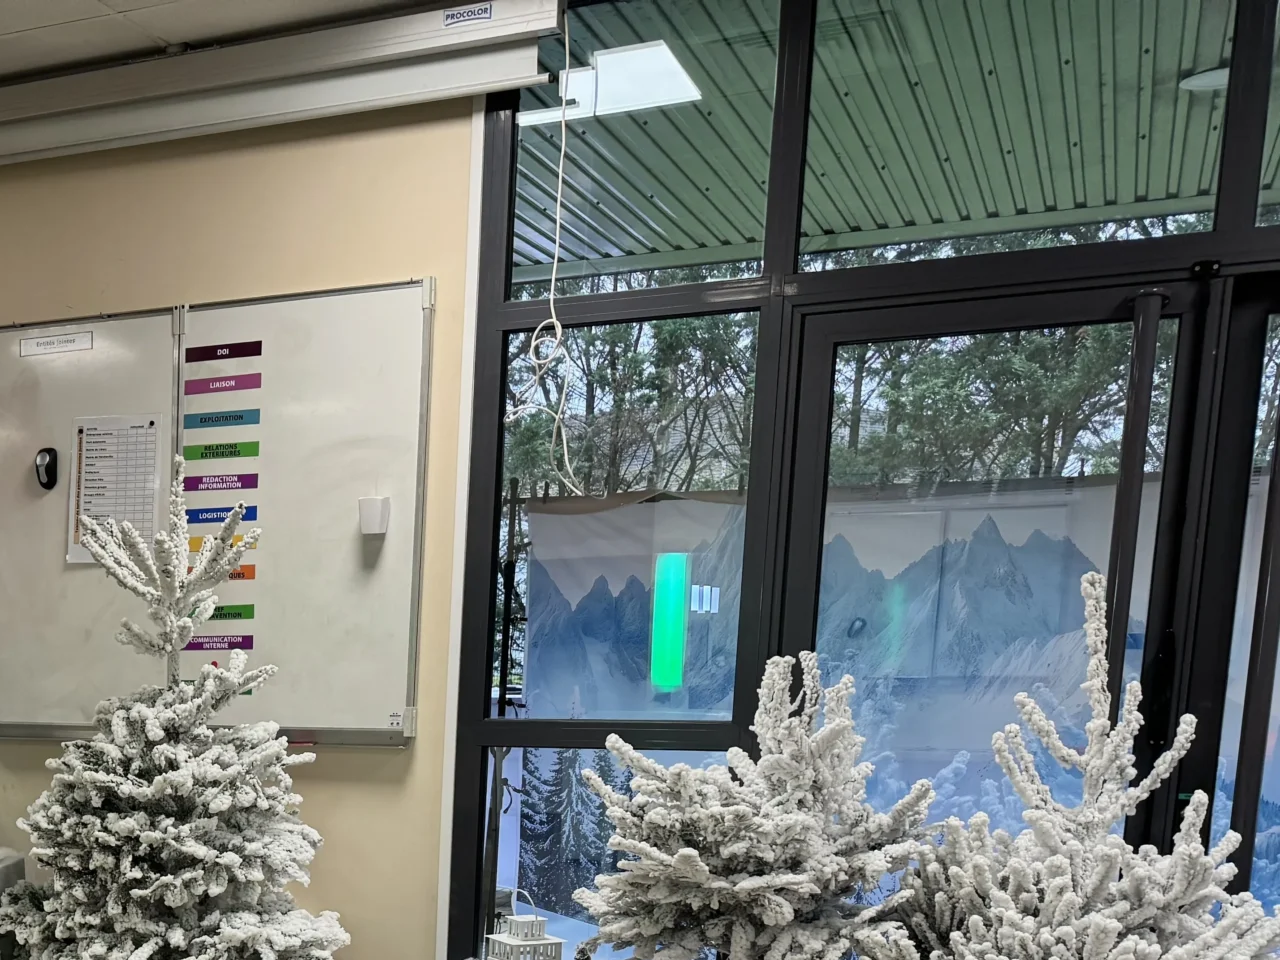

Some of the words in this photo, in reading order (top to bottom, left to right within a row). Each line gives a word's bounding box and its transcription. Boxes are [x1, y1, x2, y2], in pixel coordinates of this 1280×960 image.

[445, 7, 489, 21] PROCOLOR
[217, 348, 229, 356] DOI
[209, 379, 235, 389] LIAISON
[199, 414, 244, 424] EXPLOITATION
[204, 443, 238, 452] RELATIONS
[198, 482, 242, 490] INFORMATION
[199, 511, 229, 520] LOGISTIQ
[190, 636, 243, 644] COMMUNICATION
